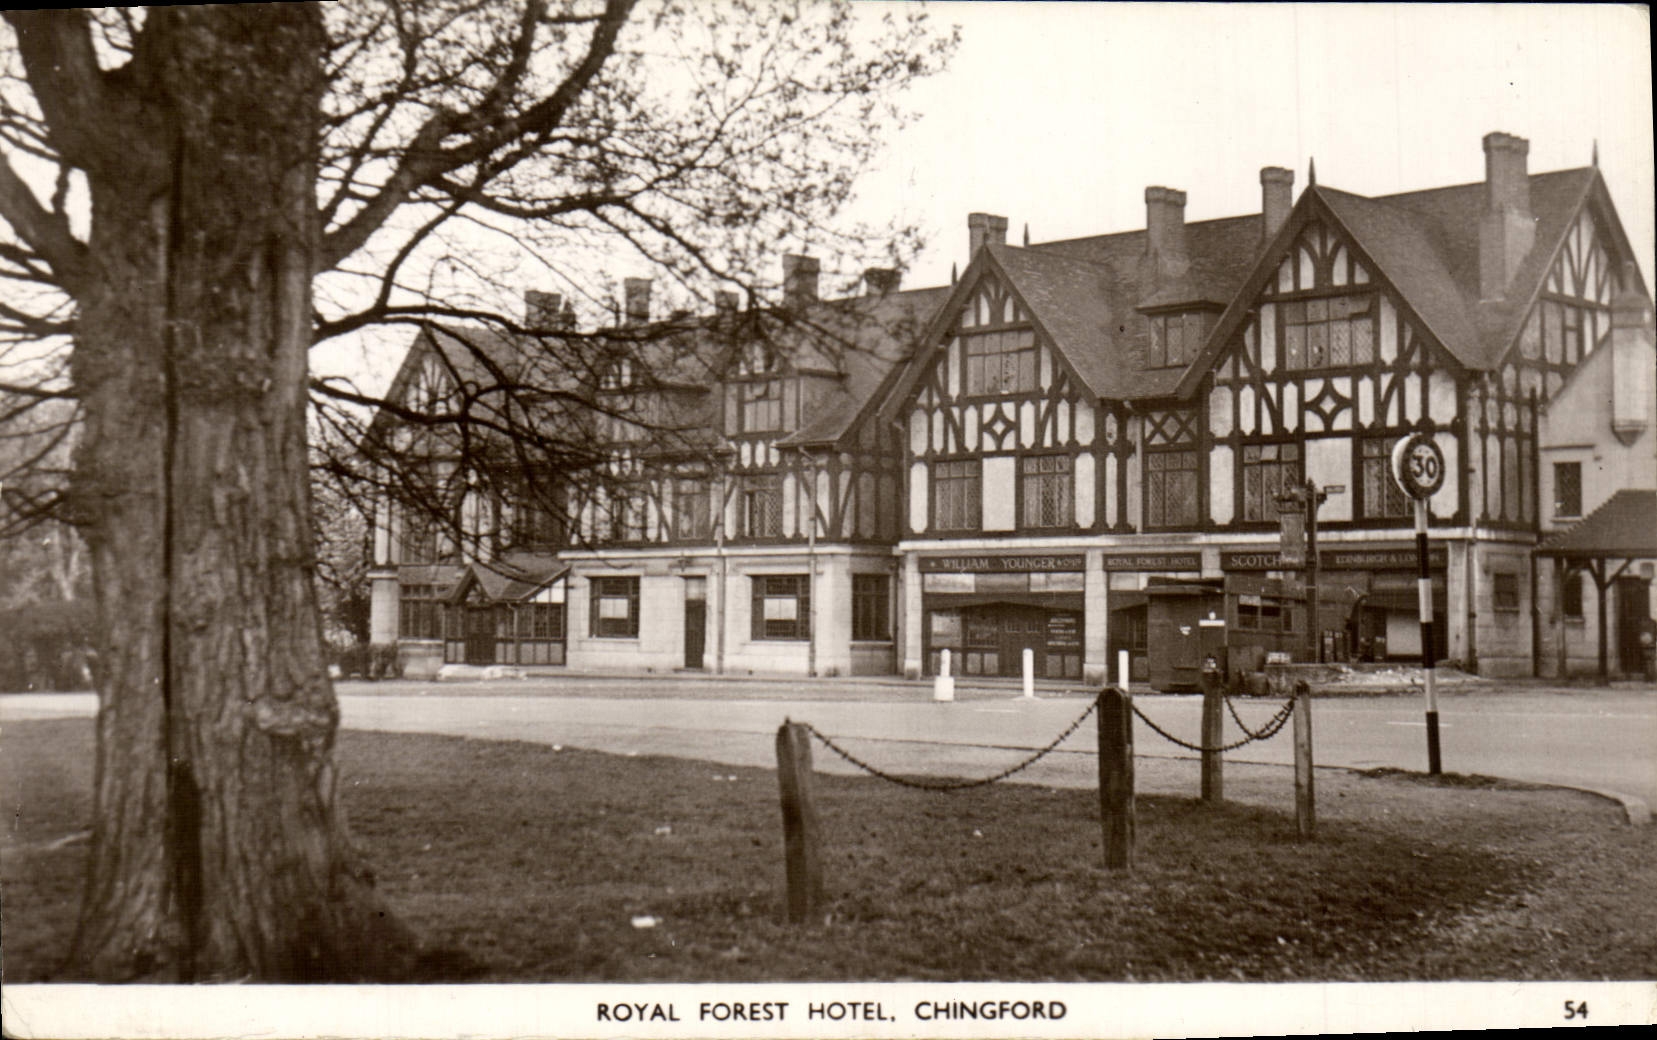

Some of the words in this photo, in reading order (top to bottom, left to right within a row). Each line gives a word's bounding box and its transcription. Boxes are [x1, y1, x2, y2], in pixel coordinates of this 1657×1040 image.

[1411, 455, 1437, 479] 30
[942, 558, 989, 569] WILLIAM
[1002, 557, 1056, 569] YOUNGER
[1231, 554, 1281, 567] SCOTCH
